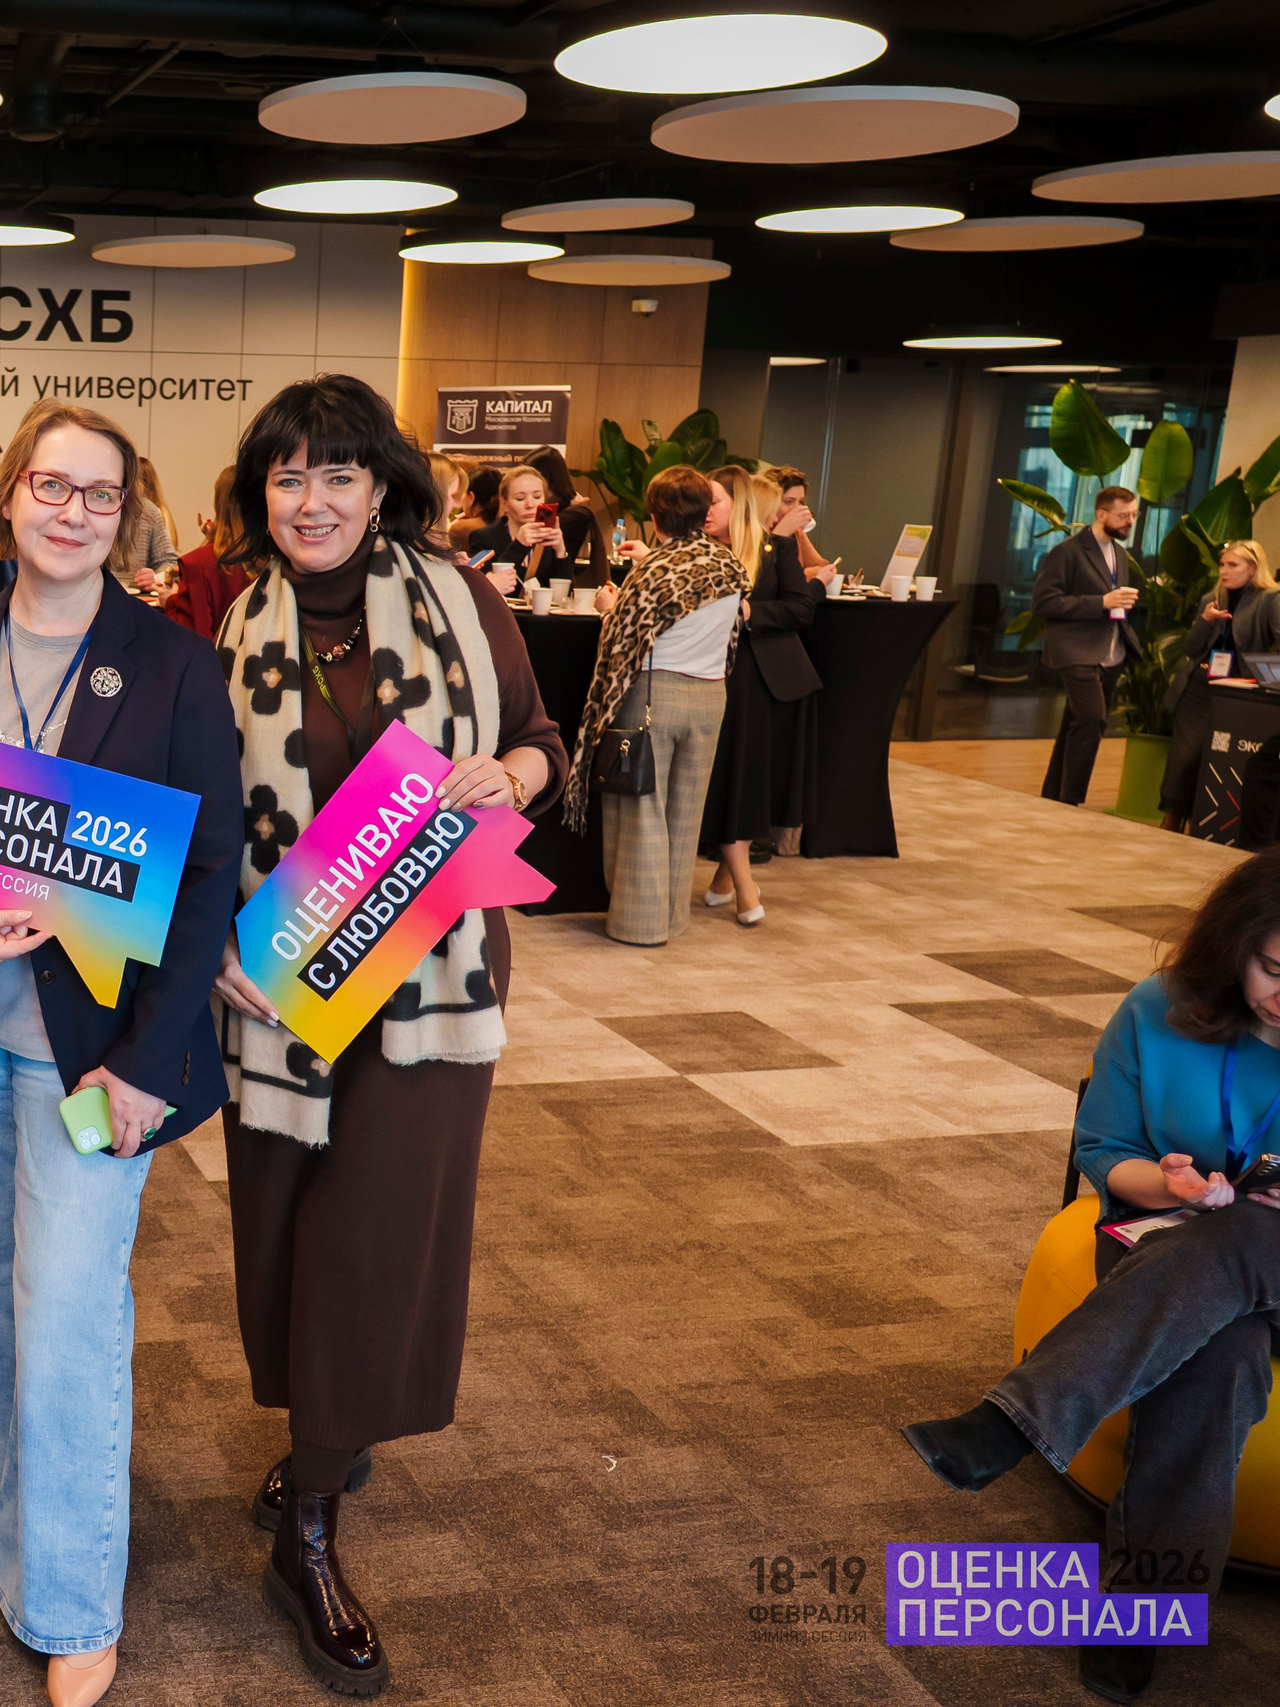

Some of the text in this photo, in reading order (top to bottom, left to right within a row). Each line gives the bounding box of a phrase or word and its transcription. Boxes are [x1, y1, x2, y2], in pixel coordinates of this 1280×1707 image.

[33, 372, 253, 407] университет
[485, 400, 552, 413] КАПИТАЛ
[71, 811, 148, 857] 2026
[271, 773, 433, 961] ОЦЕНИВАЮ
[308, 811, 464, 990] С ЛЮБОВЬЮ
